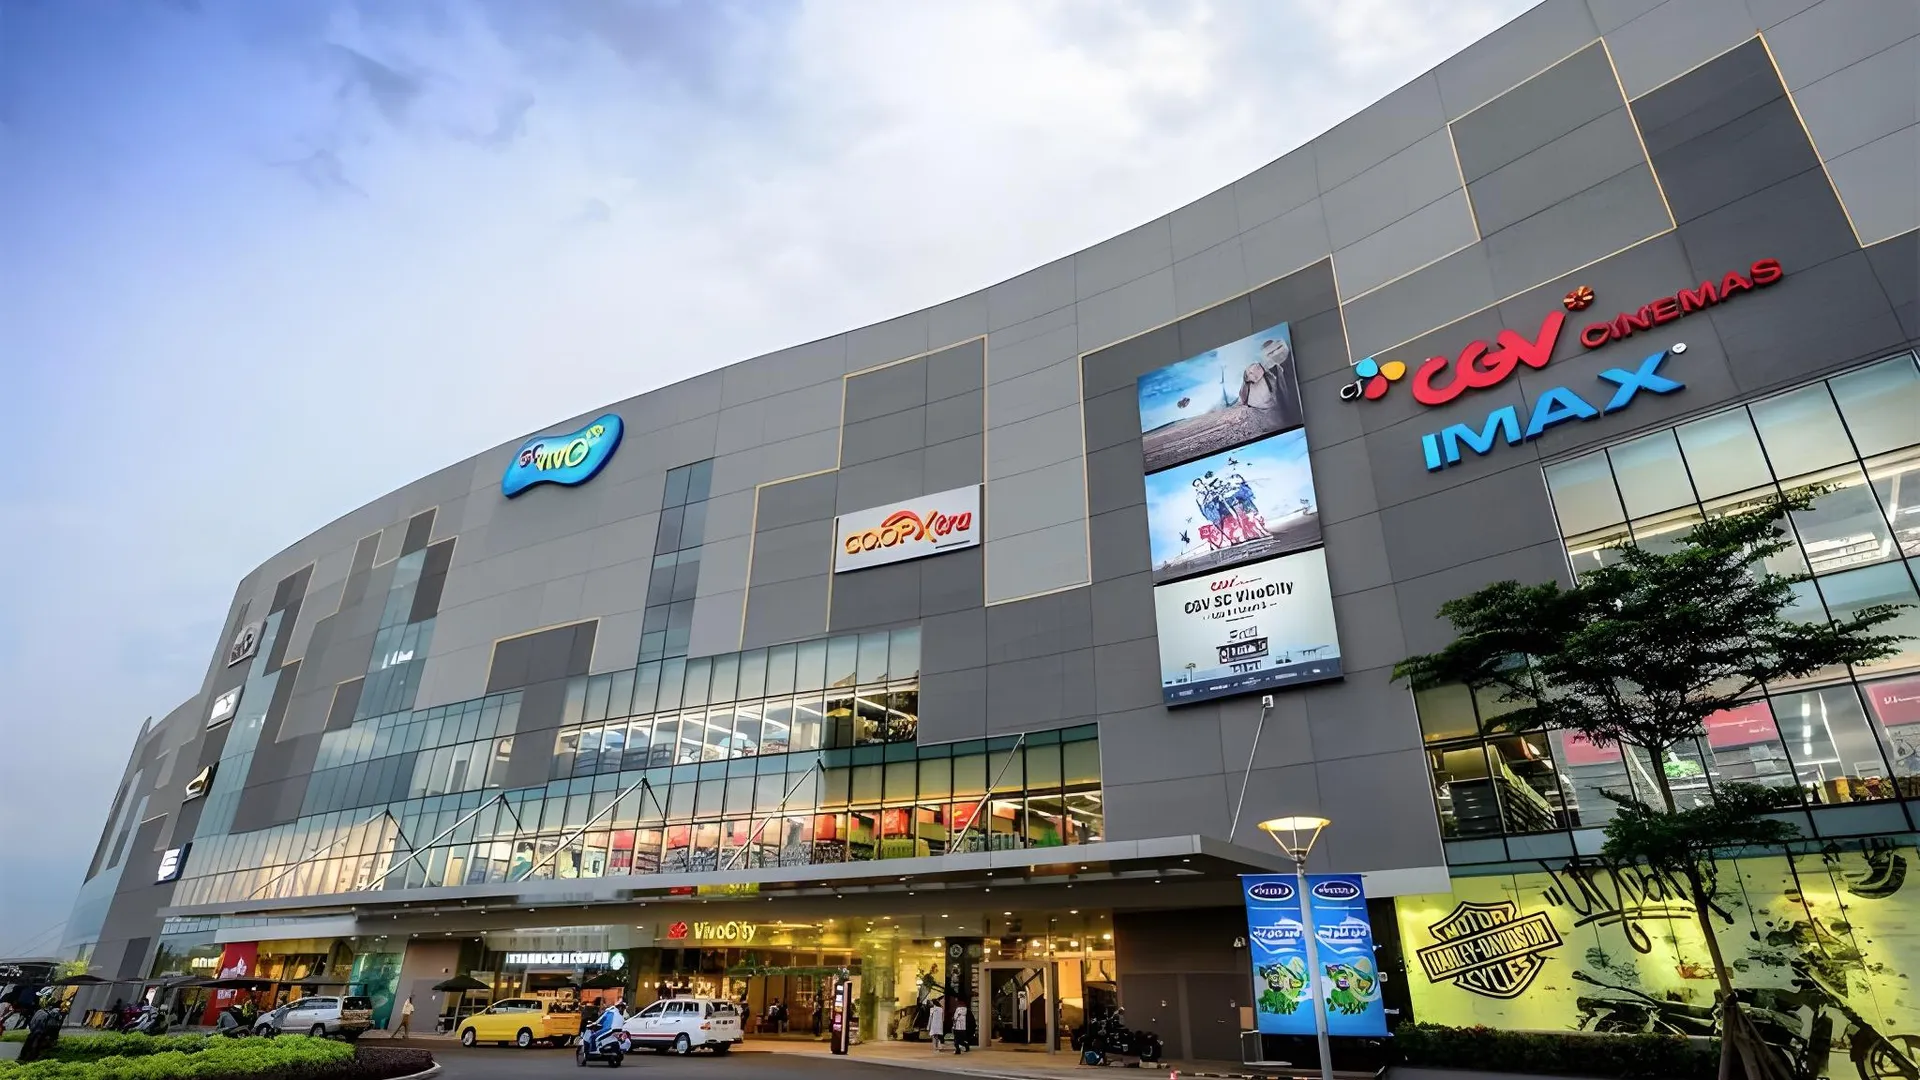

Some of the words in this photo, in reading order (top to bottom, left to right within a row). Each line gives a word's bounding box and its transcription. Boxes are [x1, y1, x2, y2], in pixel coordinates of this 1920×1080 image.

[1412, 310, 1566, 405] CGV
[1580, 257, 1784, 349] CINEMAS
[1421, 350, 1686, 472] IMAX
[1427, 919, 1549, 975] HARLEY-DAVIDSON
